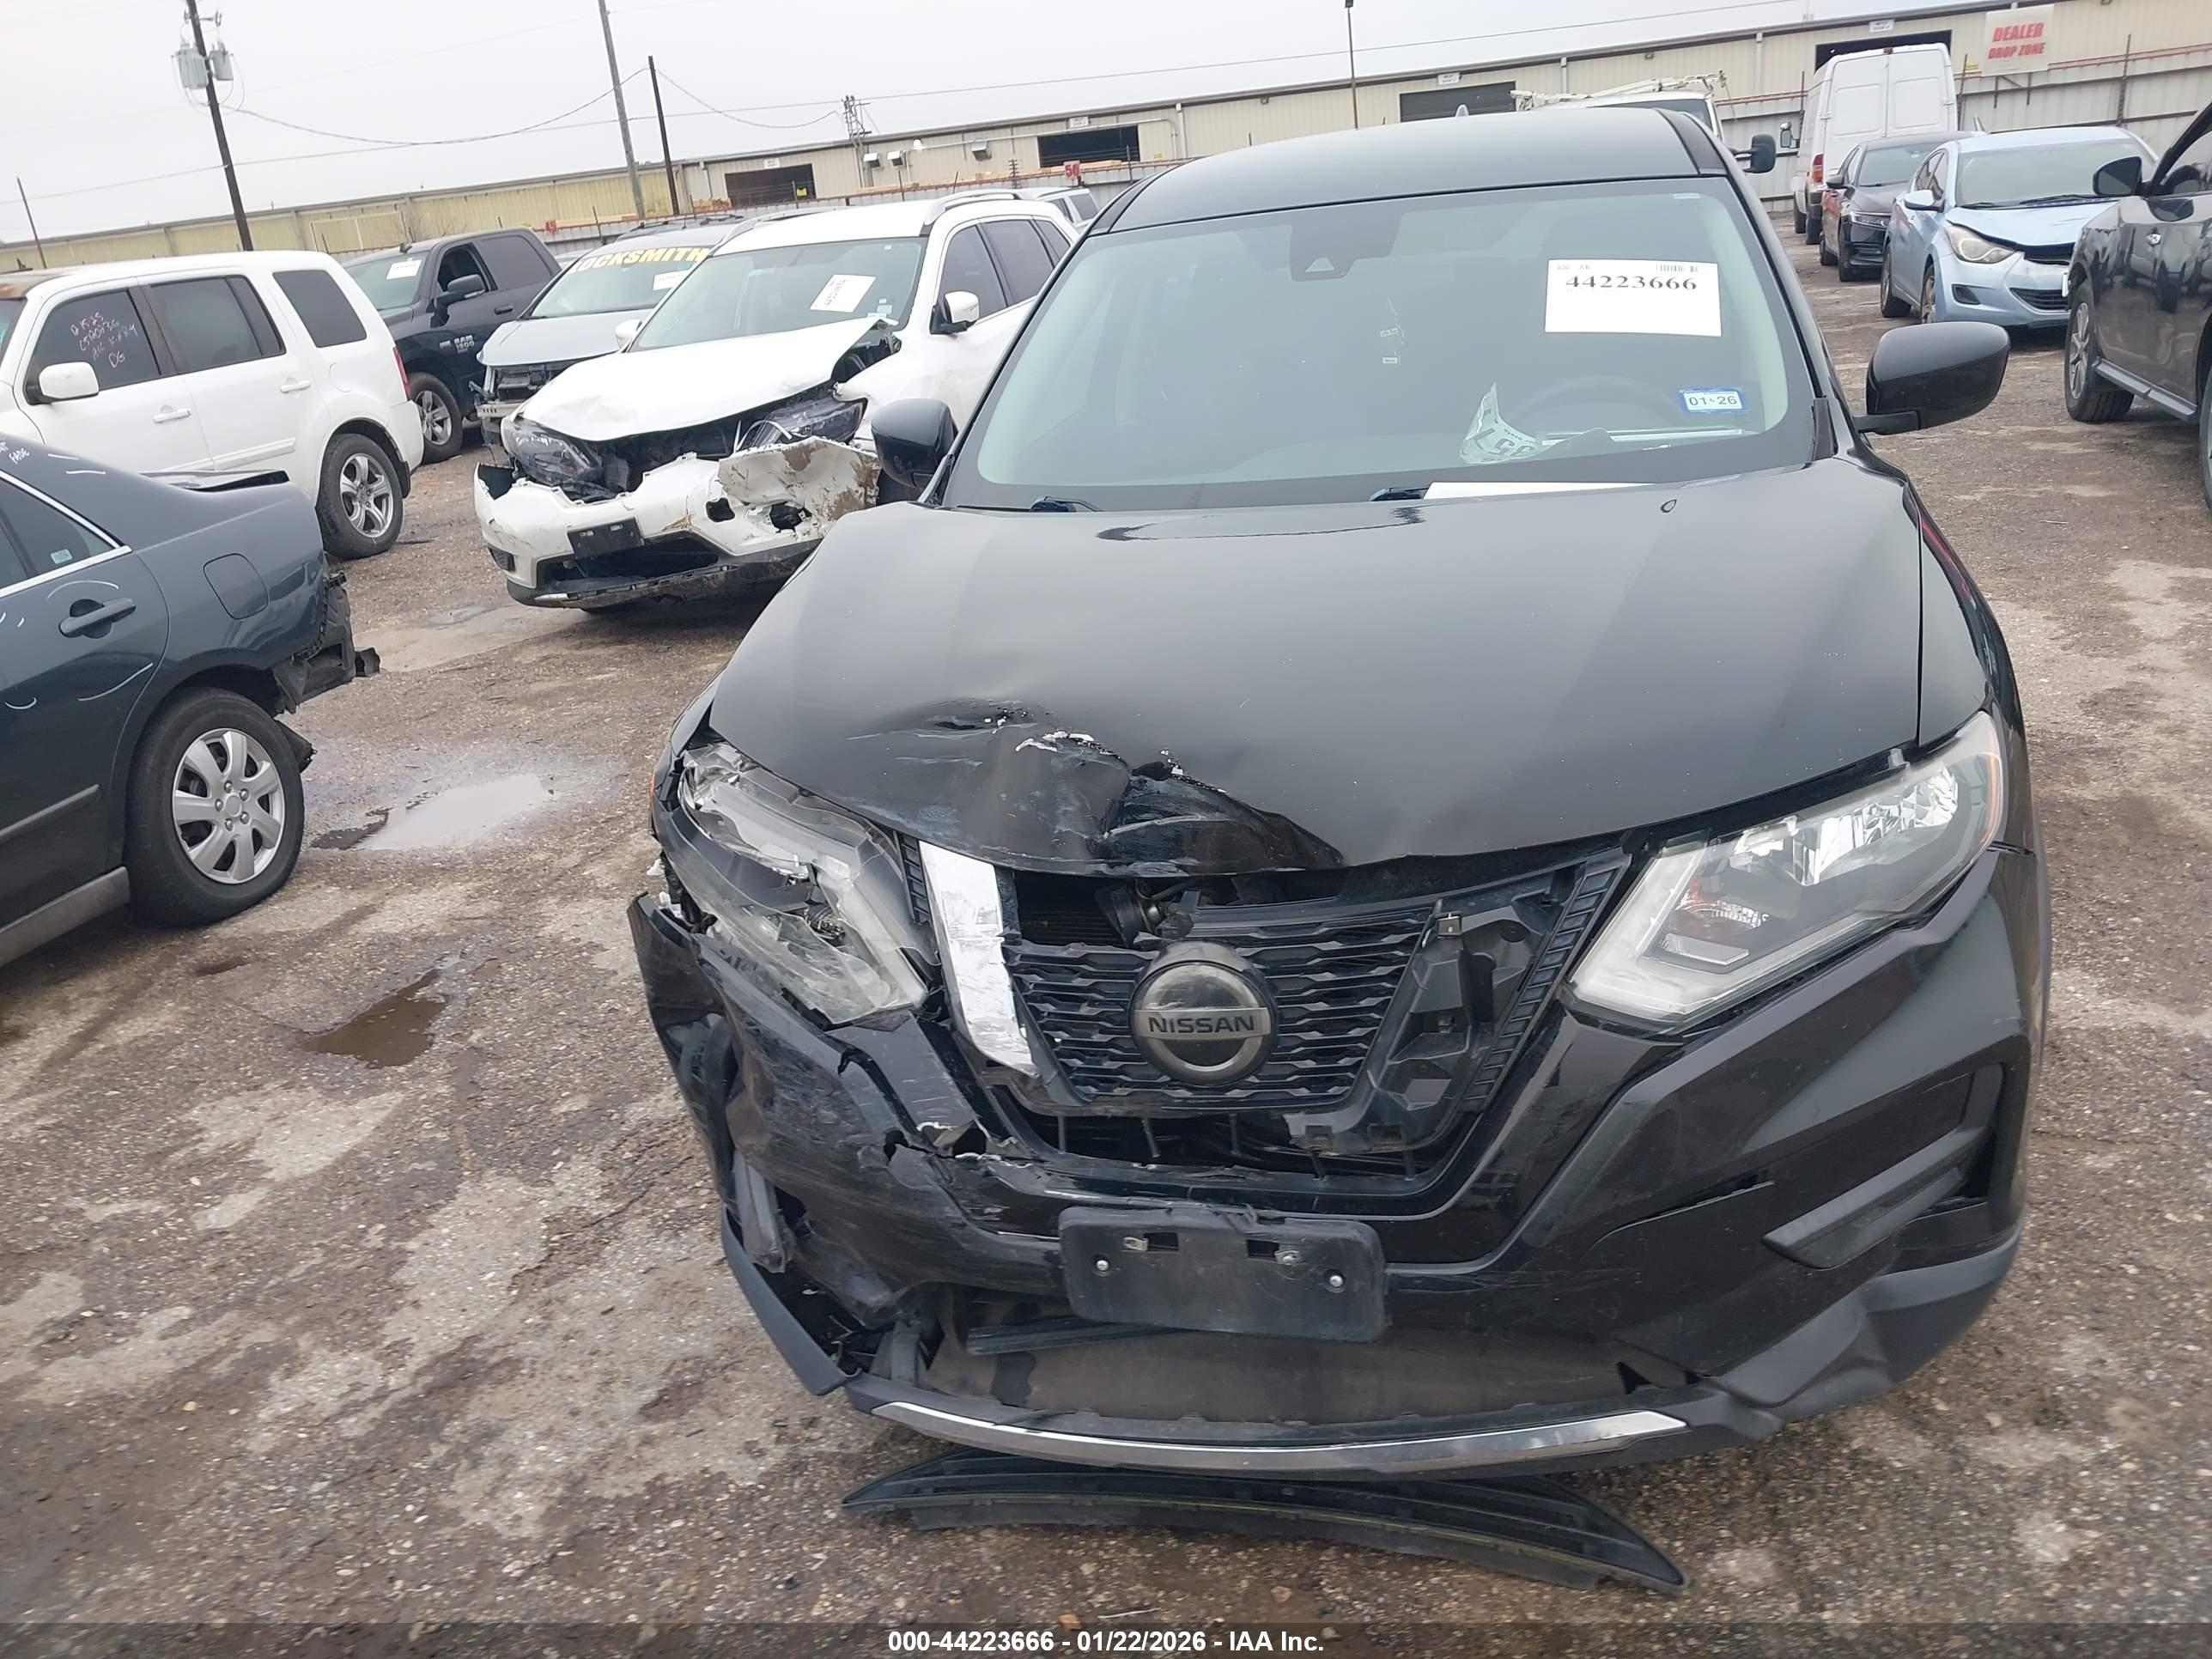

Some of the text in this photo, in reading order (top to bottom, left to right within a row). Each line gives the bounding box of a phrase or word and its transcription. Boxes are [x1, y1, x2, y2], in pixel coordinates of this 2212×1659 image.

[1992, 22, 2044, 42] DEALER
[1987, 42, 2045, 59] DROP ZONE
[569, 246, 710, 274] LOCKSMITH
[1565, 275, 1698, 290] 44223666
[1147, 1015, 1255, 1034] NISSAN
